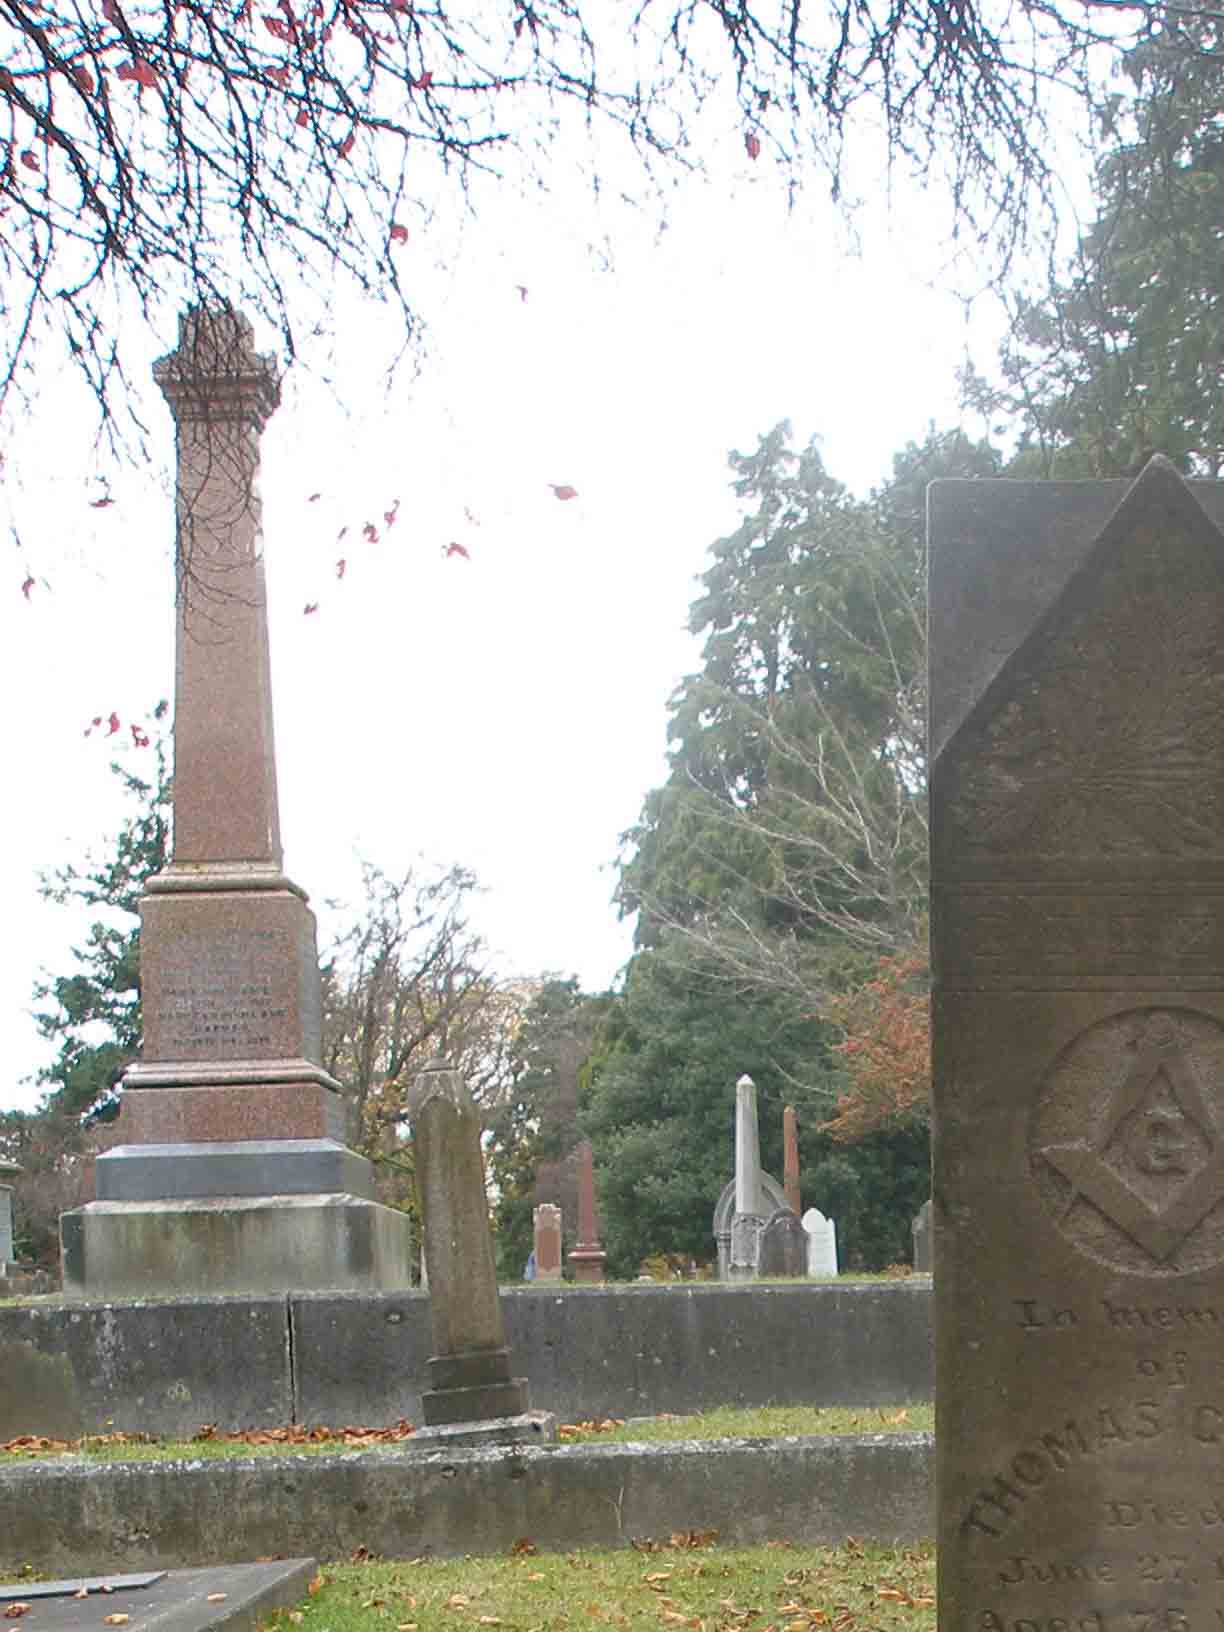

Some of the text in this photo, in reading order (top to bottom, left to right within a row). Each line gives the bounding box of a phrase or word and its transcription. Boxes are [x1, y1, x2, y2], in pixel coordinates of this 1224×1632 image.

[1013, 1300, 1080, 1331] In
[1136, 1350, 1190, 1389] of
[959, 1400, 1164, 1538] THOMAS
[997, 1552, 1117, 1585] June
